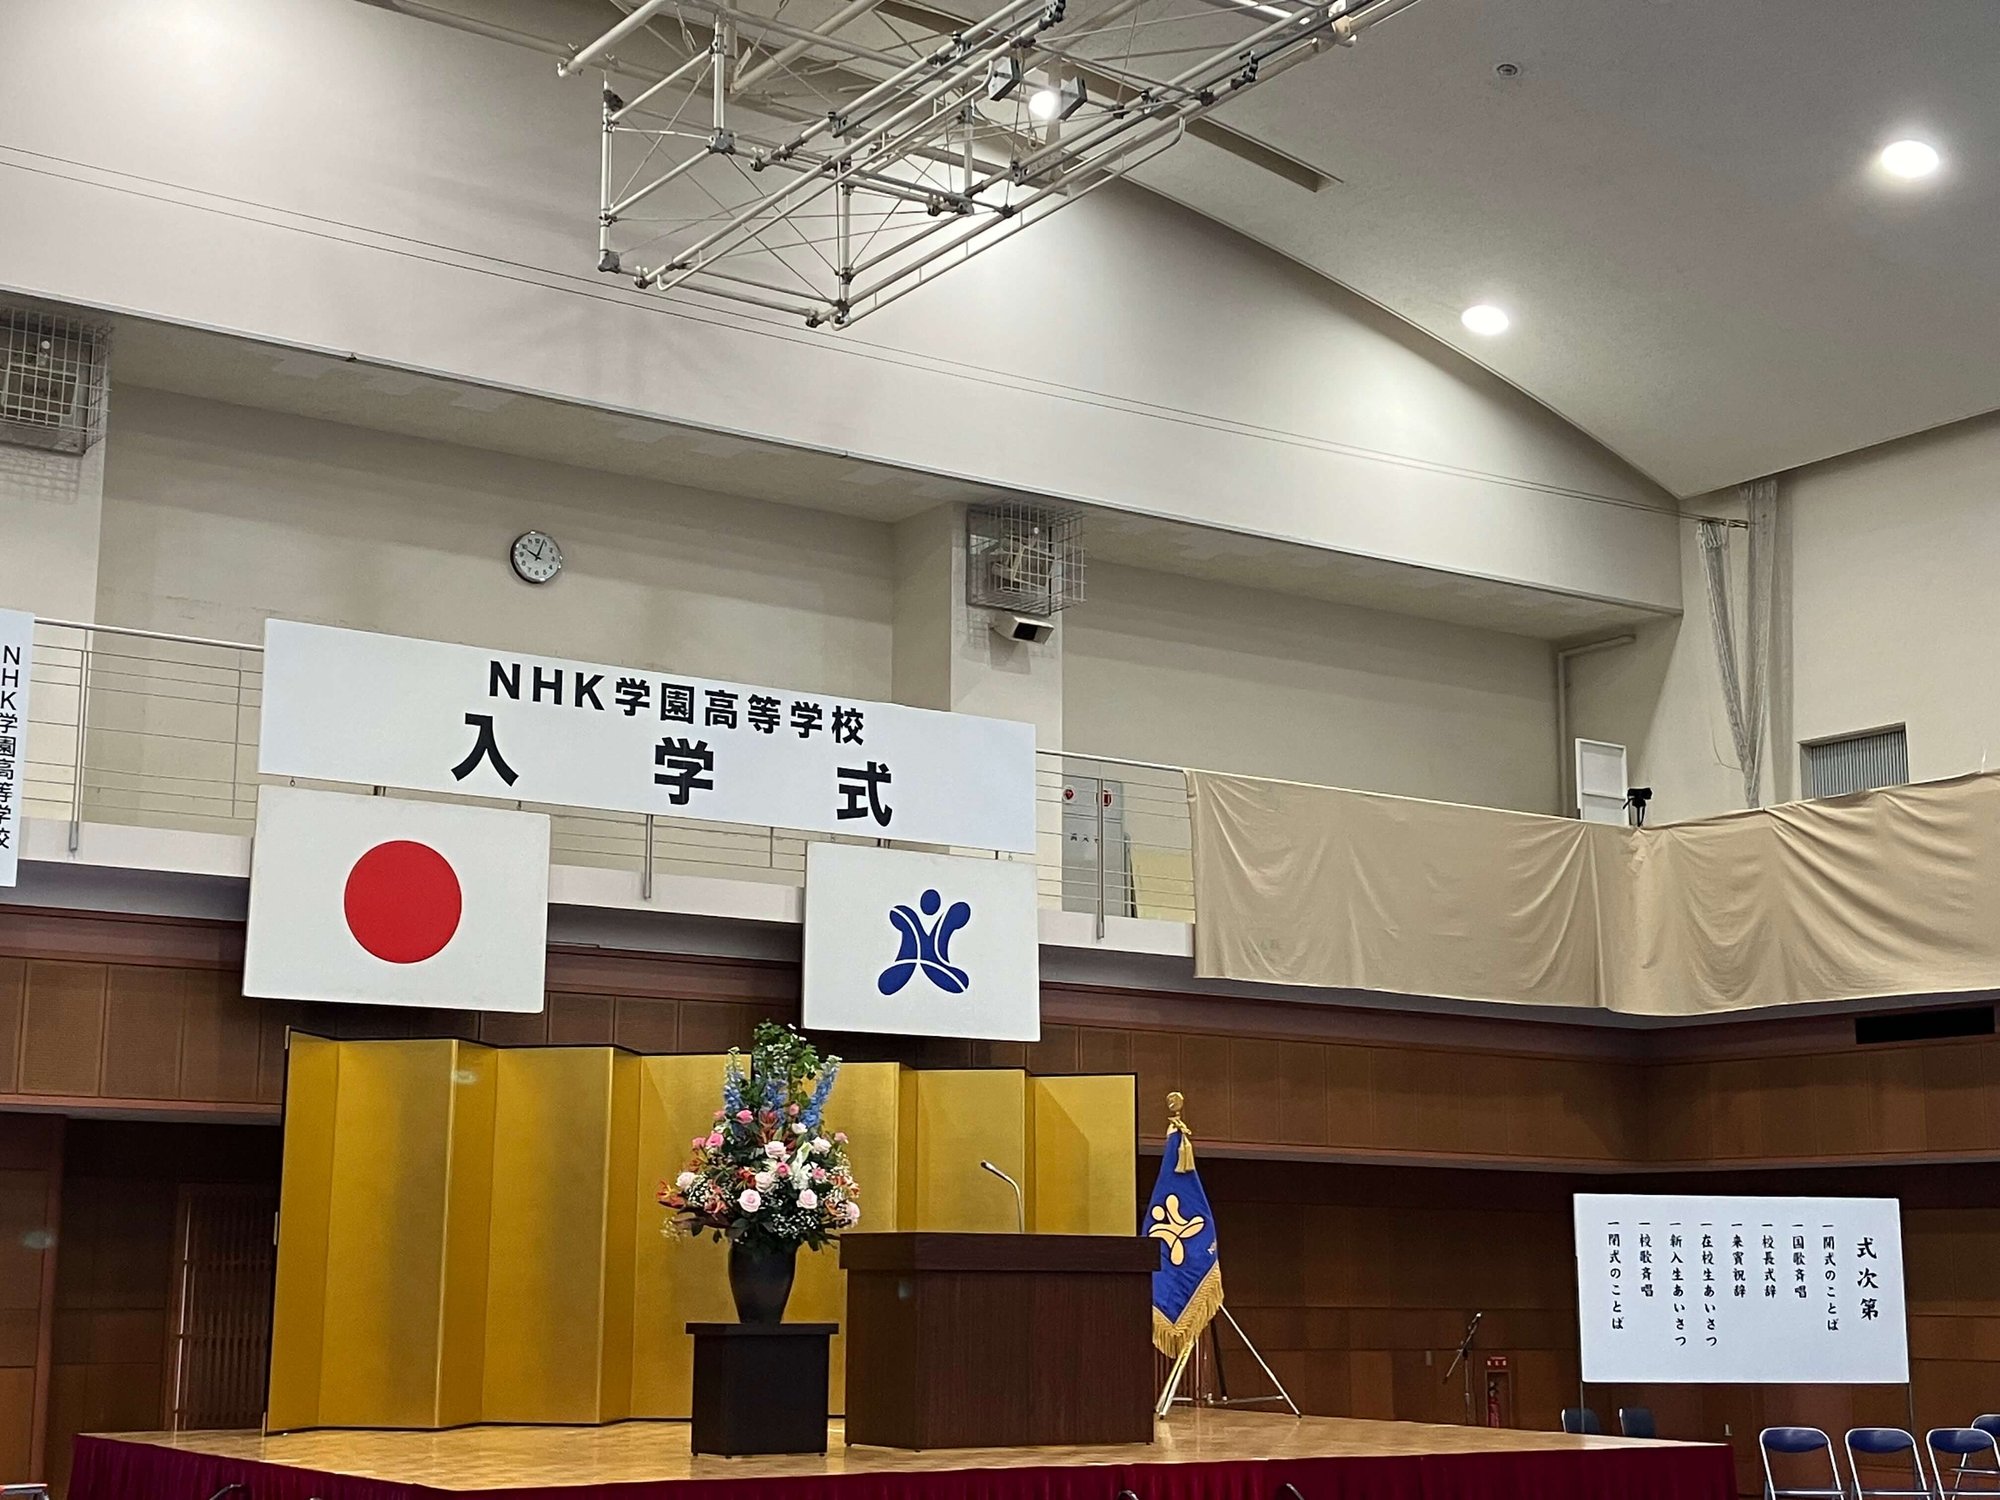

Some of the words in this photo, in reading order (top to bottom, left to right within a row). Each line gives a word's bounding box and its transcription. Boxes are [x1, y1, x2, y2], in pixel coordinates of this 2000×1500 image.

[489, 660, 864, 746] NHK学園高等学校
[1857, 1236, 1880, 1321] 式次第
